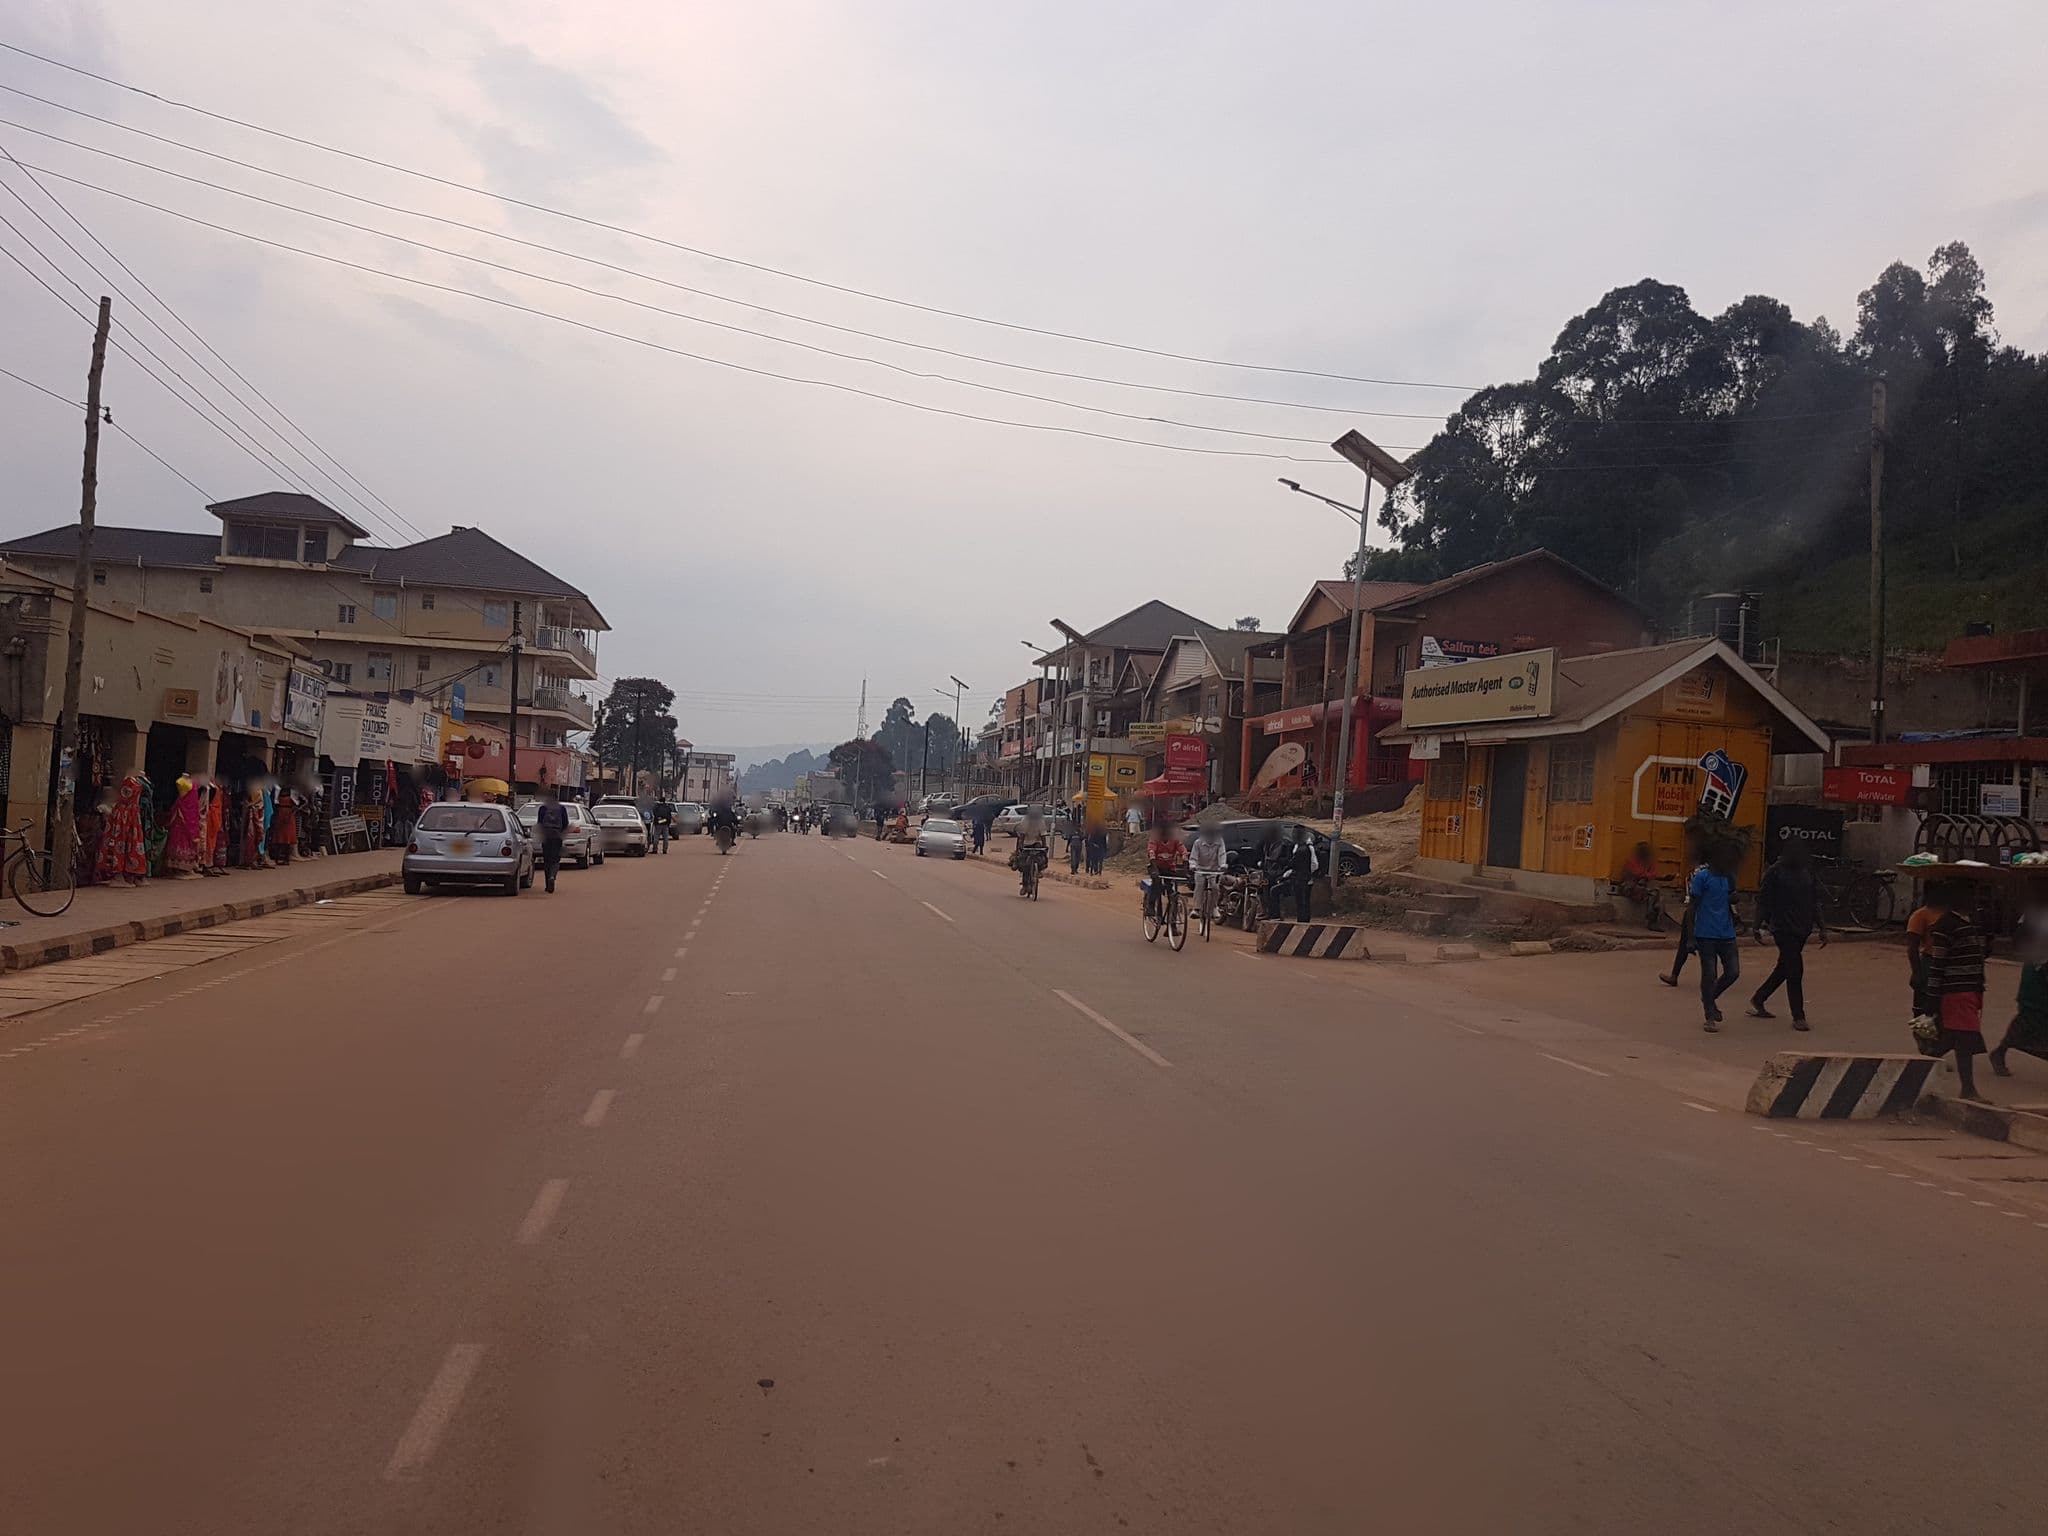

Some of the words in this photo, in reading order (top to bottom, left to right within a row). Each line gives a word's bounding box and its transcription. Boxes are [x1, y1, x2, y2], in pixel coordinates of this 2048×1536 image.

[1411, 681, 1450, 700] Authorised
[1450, 680, 1477, 695] Master
[1478, 676, 1503, 694] Agent
[1182, 743, 1201, 752] airtel
[1659, 766, 1695, 785] MTN
[1858, 772, 1897, 785] TOTAL
[1657, 786, 1691, 800] Mobile
[1857, 790, 1897, 802] Air/Water
[1656, 800, 1685, 815] Money
[1791, 827, 1837, 841] TOTAL
